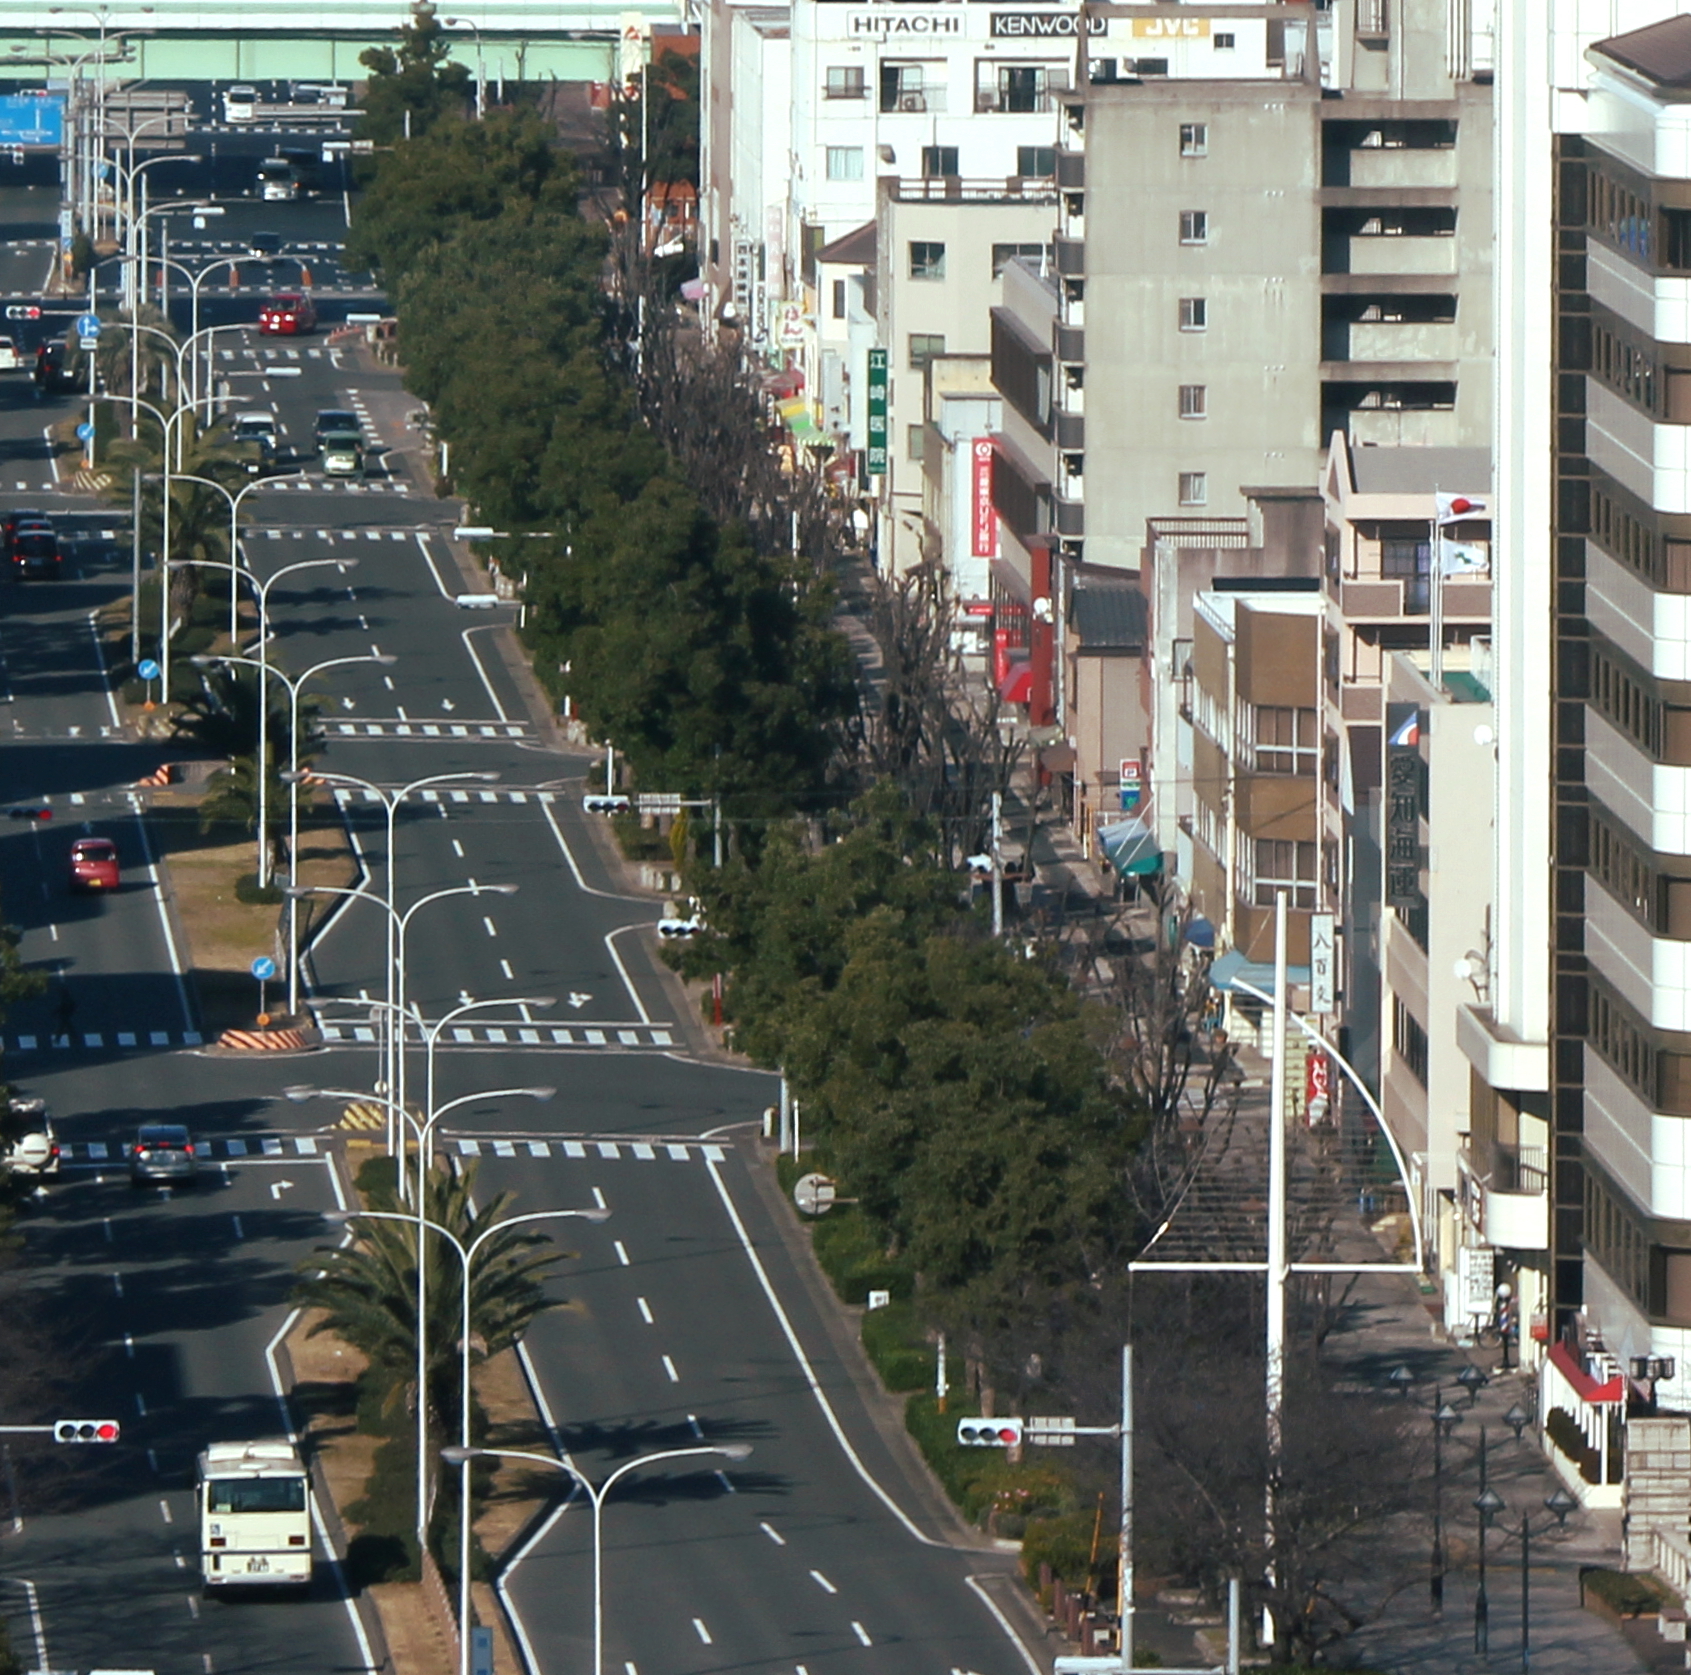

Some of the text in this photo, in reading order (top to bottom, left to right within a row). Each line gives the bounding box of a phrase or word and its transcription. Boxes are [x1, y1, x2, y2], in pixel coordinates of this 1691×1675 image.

[853, 15, 960, 33] HITACHI
[1145, 16, 1200, 35] JVC
[1389, 753, 1416, 899] 愛知海運
